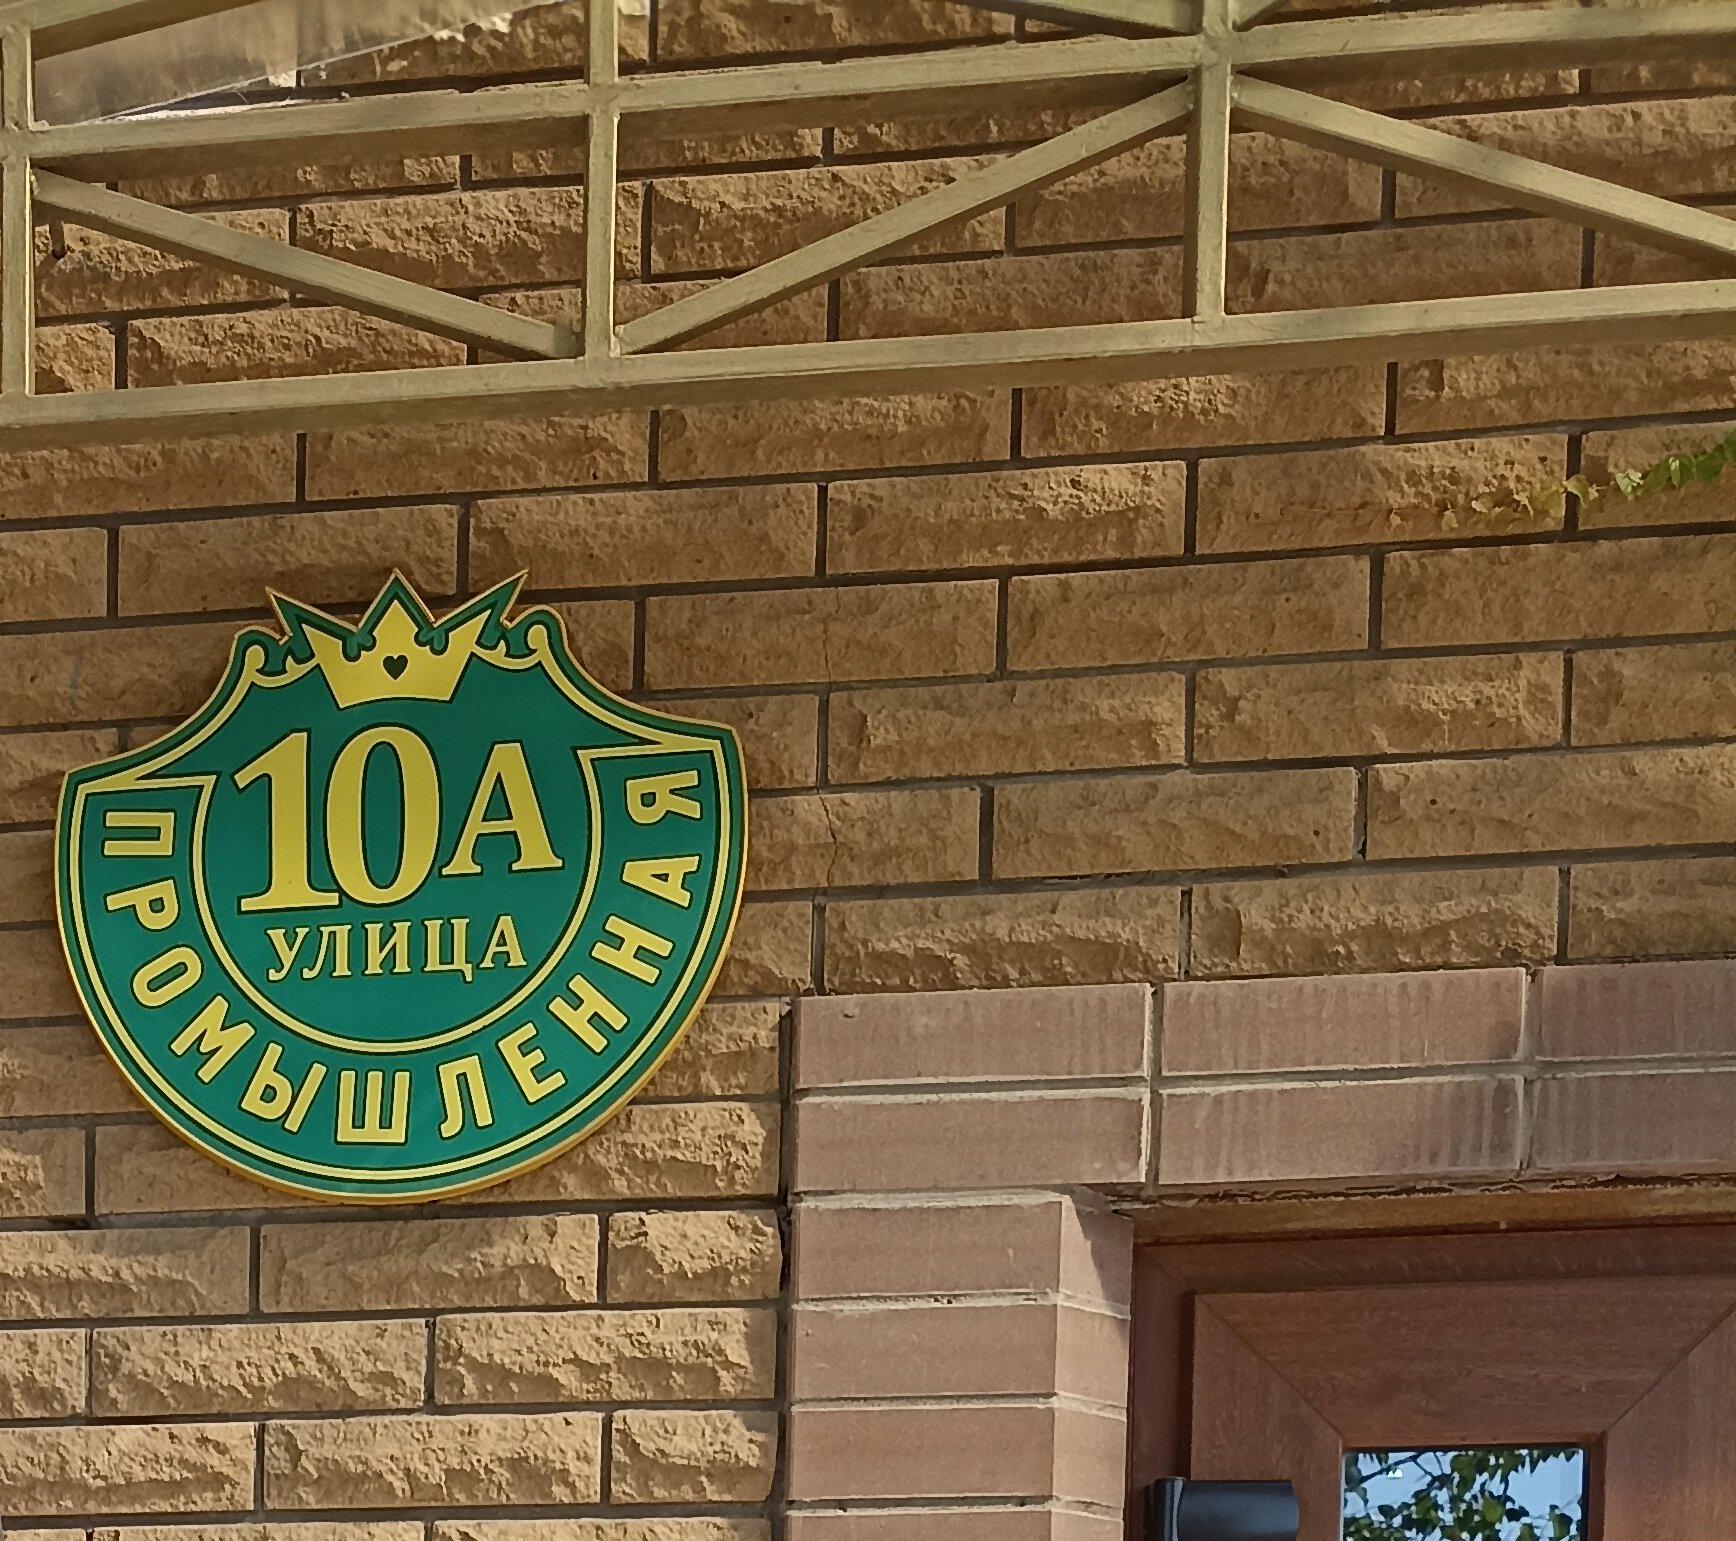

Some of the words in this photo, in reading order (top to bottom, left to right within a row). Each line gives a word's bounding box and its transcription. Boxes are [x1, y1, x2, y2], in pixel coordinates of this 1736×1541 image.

[232, 726, 563, 914] 10А
[102, 768, 702, 1145] ПРОМЫШЛЕННАЯ
[266, 914, 528, 982] УЛИЦА
